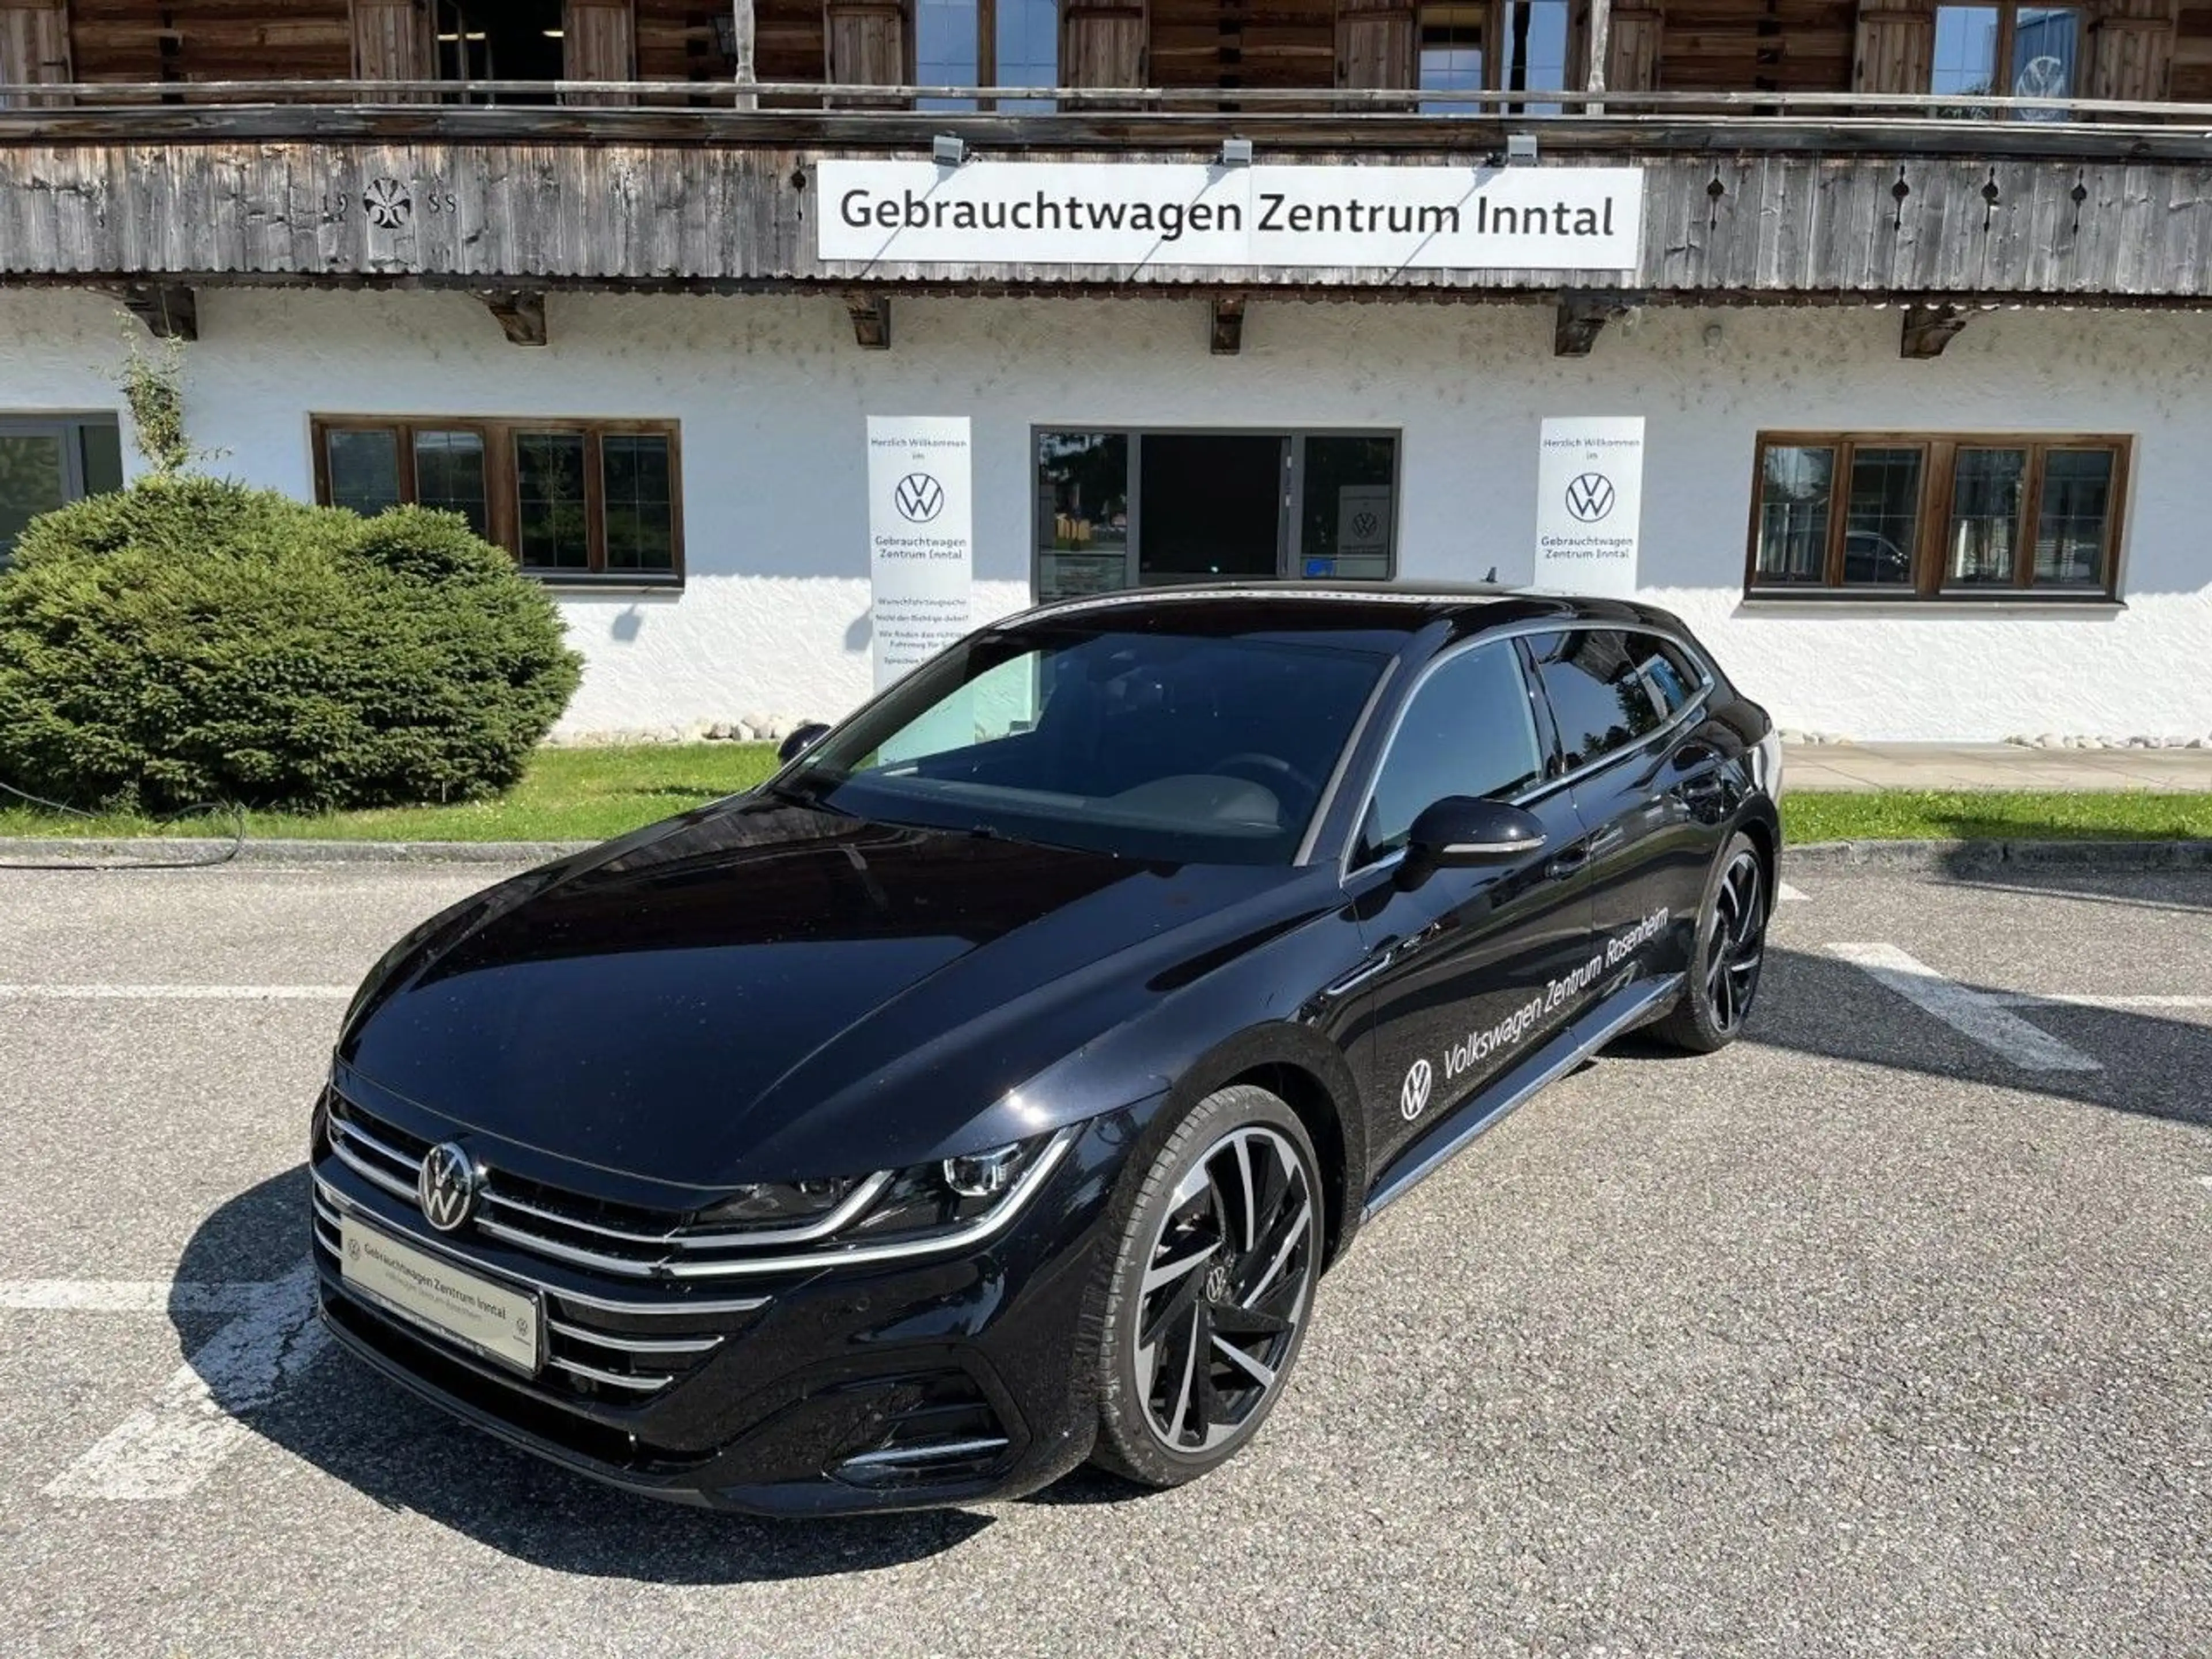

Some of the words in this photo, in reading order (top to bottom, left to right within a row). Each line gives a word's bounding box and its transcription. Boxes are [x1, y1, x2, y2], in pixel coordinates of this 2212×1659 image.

[839, 190, 1241, 241] Gebrauchtwagen
[1258, 193, 1459, 235] Zentrum
[1477, 196, 1614, 236] Inntal
[871, 438, 907, 447] Herzlich
[909, 438, 967, 447] Willkommen
[1543, 439, 1582, 447] Herzlich
[1584, 438, 1641, 447] Willkommen
[875, 536, 967, 548] Gebrauchtwagen
[1541, 536, 1634, 548] Gebrauchtwagen
[880, 548, 926, 559] Zentrum
[929, 548, 963, 559] Inntal
[1546, 549, 1593, 559] Zentrum
[1596, 549, 1630, 558] Inntal
[1444, 998, 1541, 1080] Volkswagen
[1544, 954, 1603, 1012] Zentrum
[1605, 907, 1669, 969] Rosenheim
[363, 1242, 433, 1287] Gebrauchtwagen
[434, 1278, 476, 1305] Zentrum
[476, 1296, 506, 1320] Inntal
